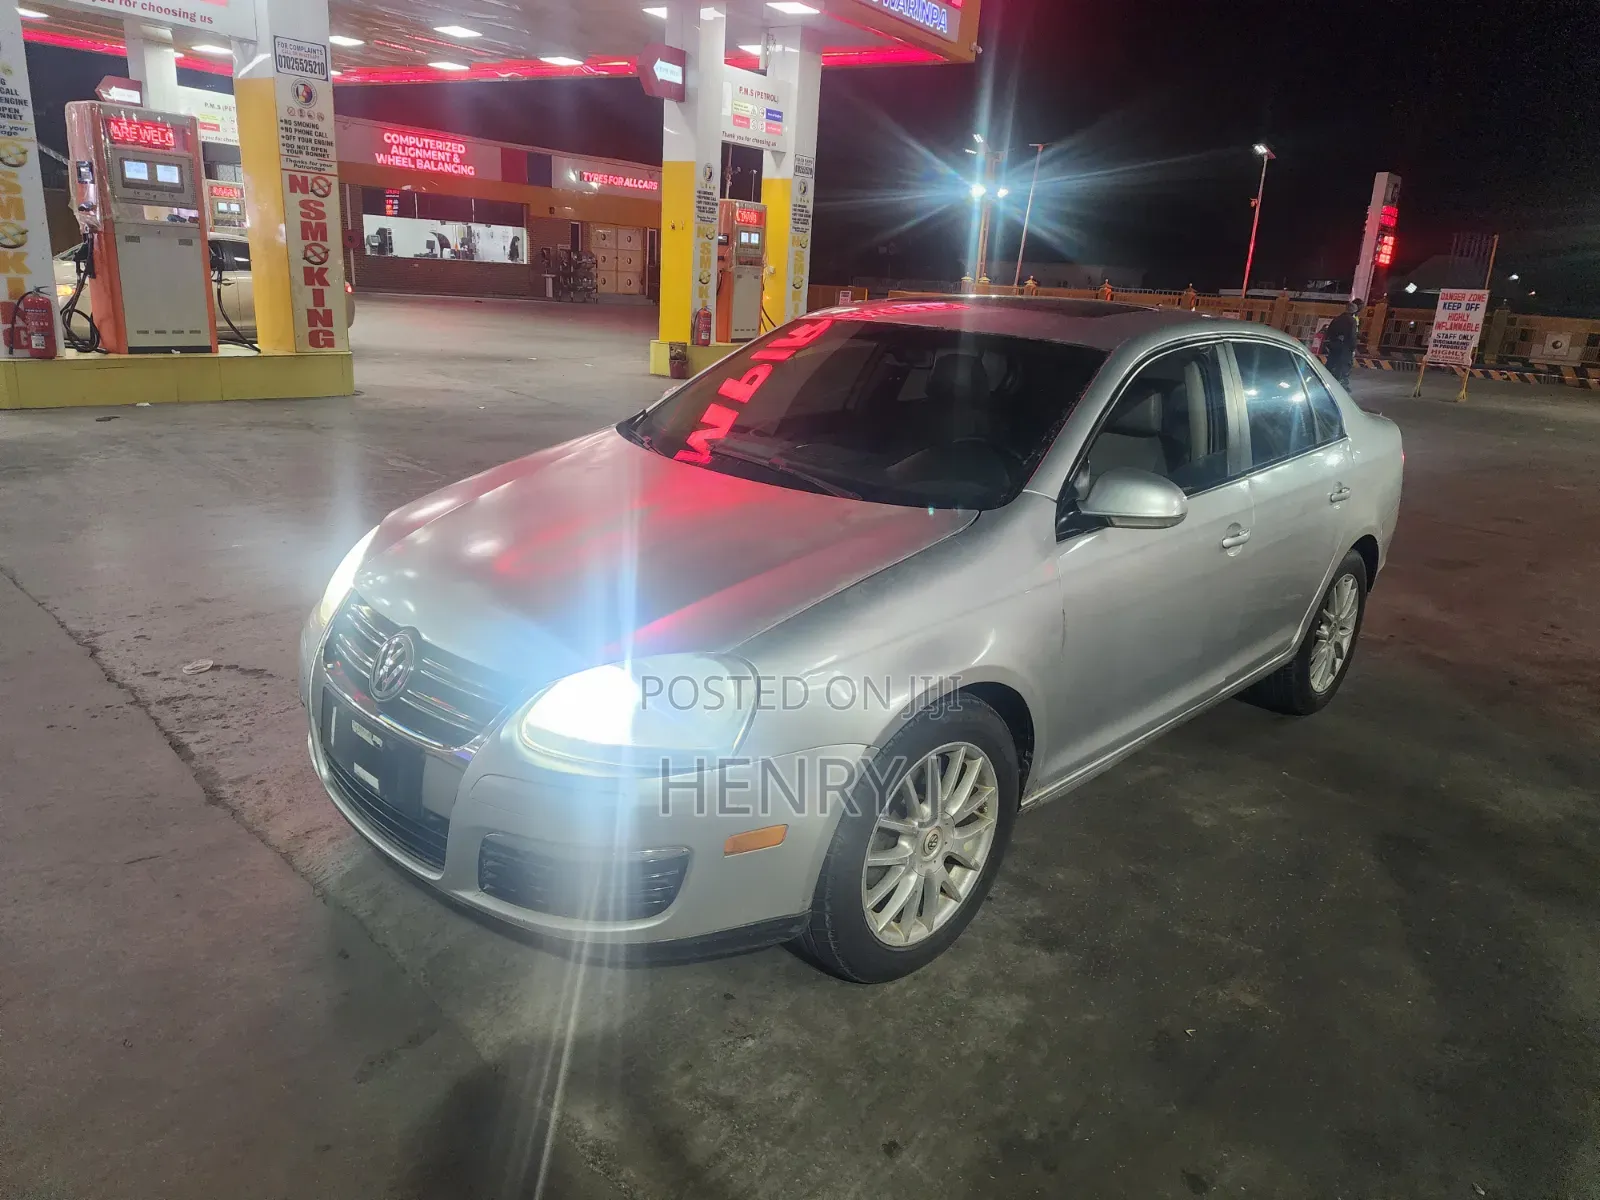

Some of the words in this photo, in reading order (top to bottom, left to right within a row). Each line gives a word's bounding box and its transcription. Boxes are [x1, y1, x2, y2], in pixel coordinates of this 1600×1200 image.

[141, 2, 197, 22] choosing
[200, 14, 214, 24] us
[870, 0, 947, 33] WARINPA
[290, 44, 323, 55] COMPLAINTS
[277, 54, 325, 75] 07025525210
[294, 120, 319, 130] SMOKING
[294, 128, 313, 136] PHONE
[298, 136, 313, 144] YOUR
[314, 139, 334, 147] ENGINE
[383, 132, 466, 154] COMPUTERIZED
[390, 145, 452, 162] ALIGNMENT
[452, 153, 461, 163] &
[286, 157, 307, 165] Thanks
[375, 153, 415, 168] WHEEL
[416, 159, 475, 175] BALANCING
[293, 163, 326, 172] Patronage
[582, 171, 608, 184] TYRES
[608, 175, 624, 186] FOR
[624, 178, 638, 188] ALL
[638, 179, 658, 190] CARS
[1440, 292, 1466, 301] DANGER
[1468, 293, 1487, 302] ZONE
[1443, 302, 1462, 311] KEEP
[1465, 302, 1480, 311] OFF
[1447, 312, 1470, 322] HIGHLY
[1434, 321, 1480, 332] INFLAMMABLE
[1436, 332, 1457, 340] STAFF
[1459, 333, 1475, 341] ONLY
[1431, 349, 1466, 357] HIGHLY
